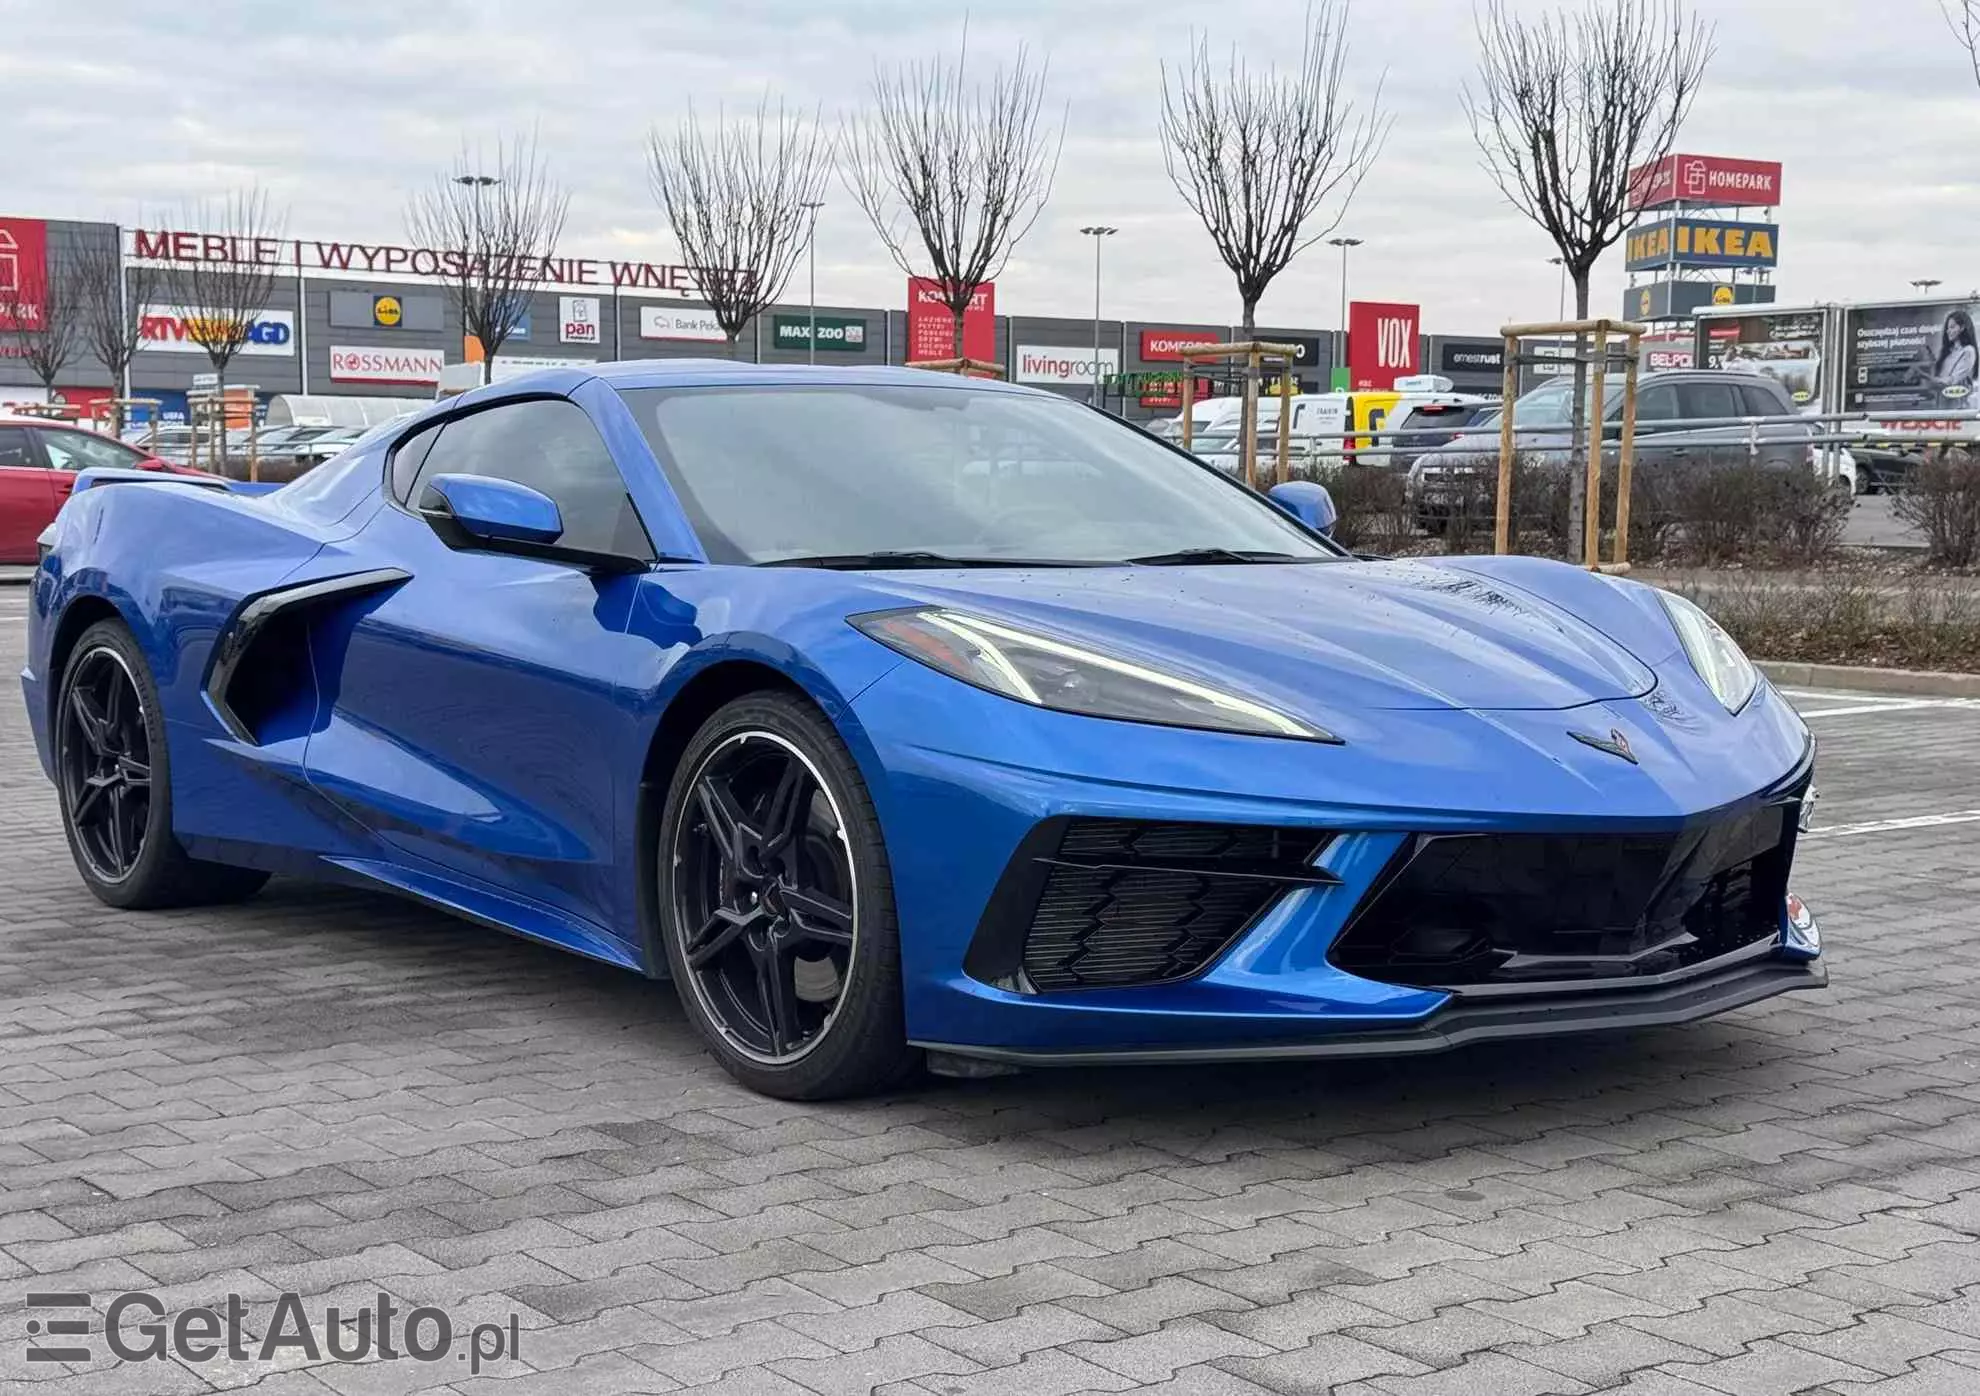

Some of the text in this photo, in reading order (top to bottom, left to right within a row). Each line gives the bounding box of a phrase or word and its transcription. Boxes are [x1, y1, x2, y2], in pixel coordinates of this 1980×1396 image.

[1708, 170, 1773, 191] HOMEPARK
[135, 229, 278, 266] MEBLE
[1628, 228, 1669, 262] IKEA
[1677, 226, 1774, 258] IKEA
[918, 290, 988, 305] KOMRT
[565, 322, 595, 339] pan
[699, 319, 722, 331] Peka
[780, 325, 844, 339] MAX ZOO
[1150, 339, 1213, 353] KOMFO
[1377, 318, 1412, 369] VOX
[333, 353, 442, 373] ROSSMANN
[1023, 354, 1115, 378] livingroom
